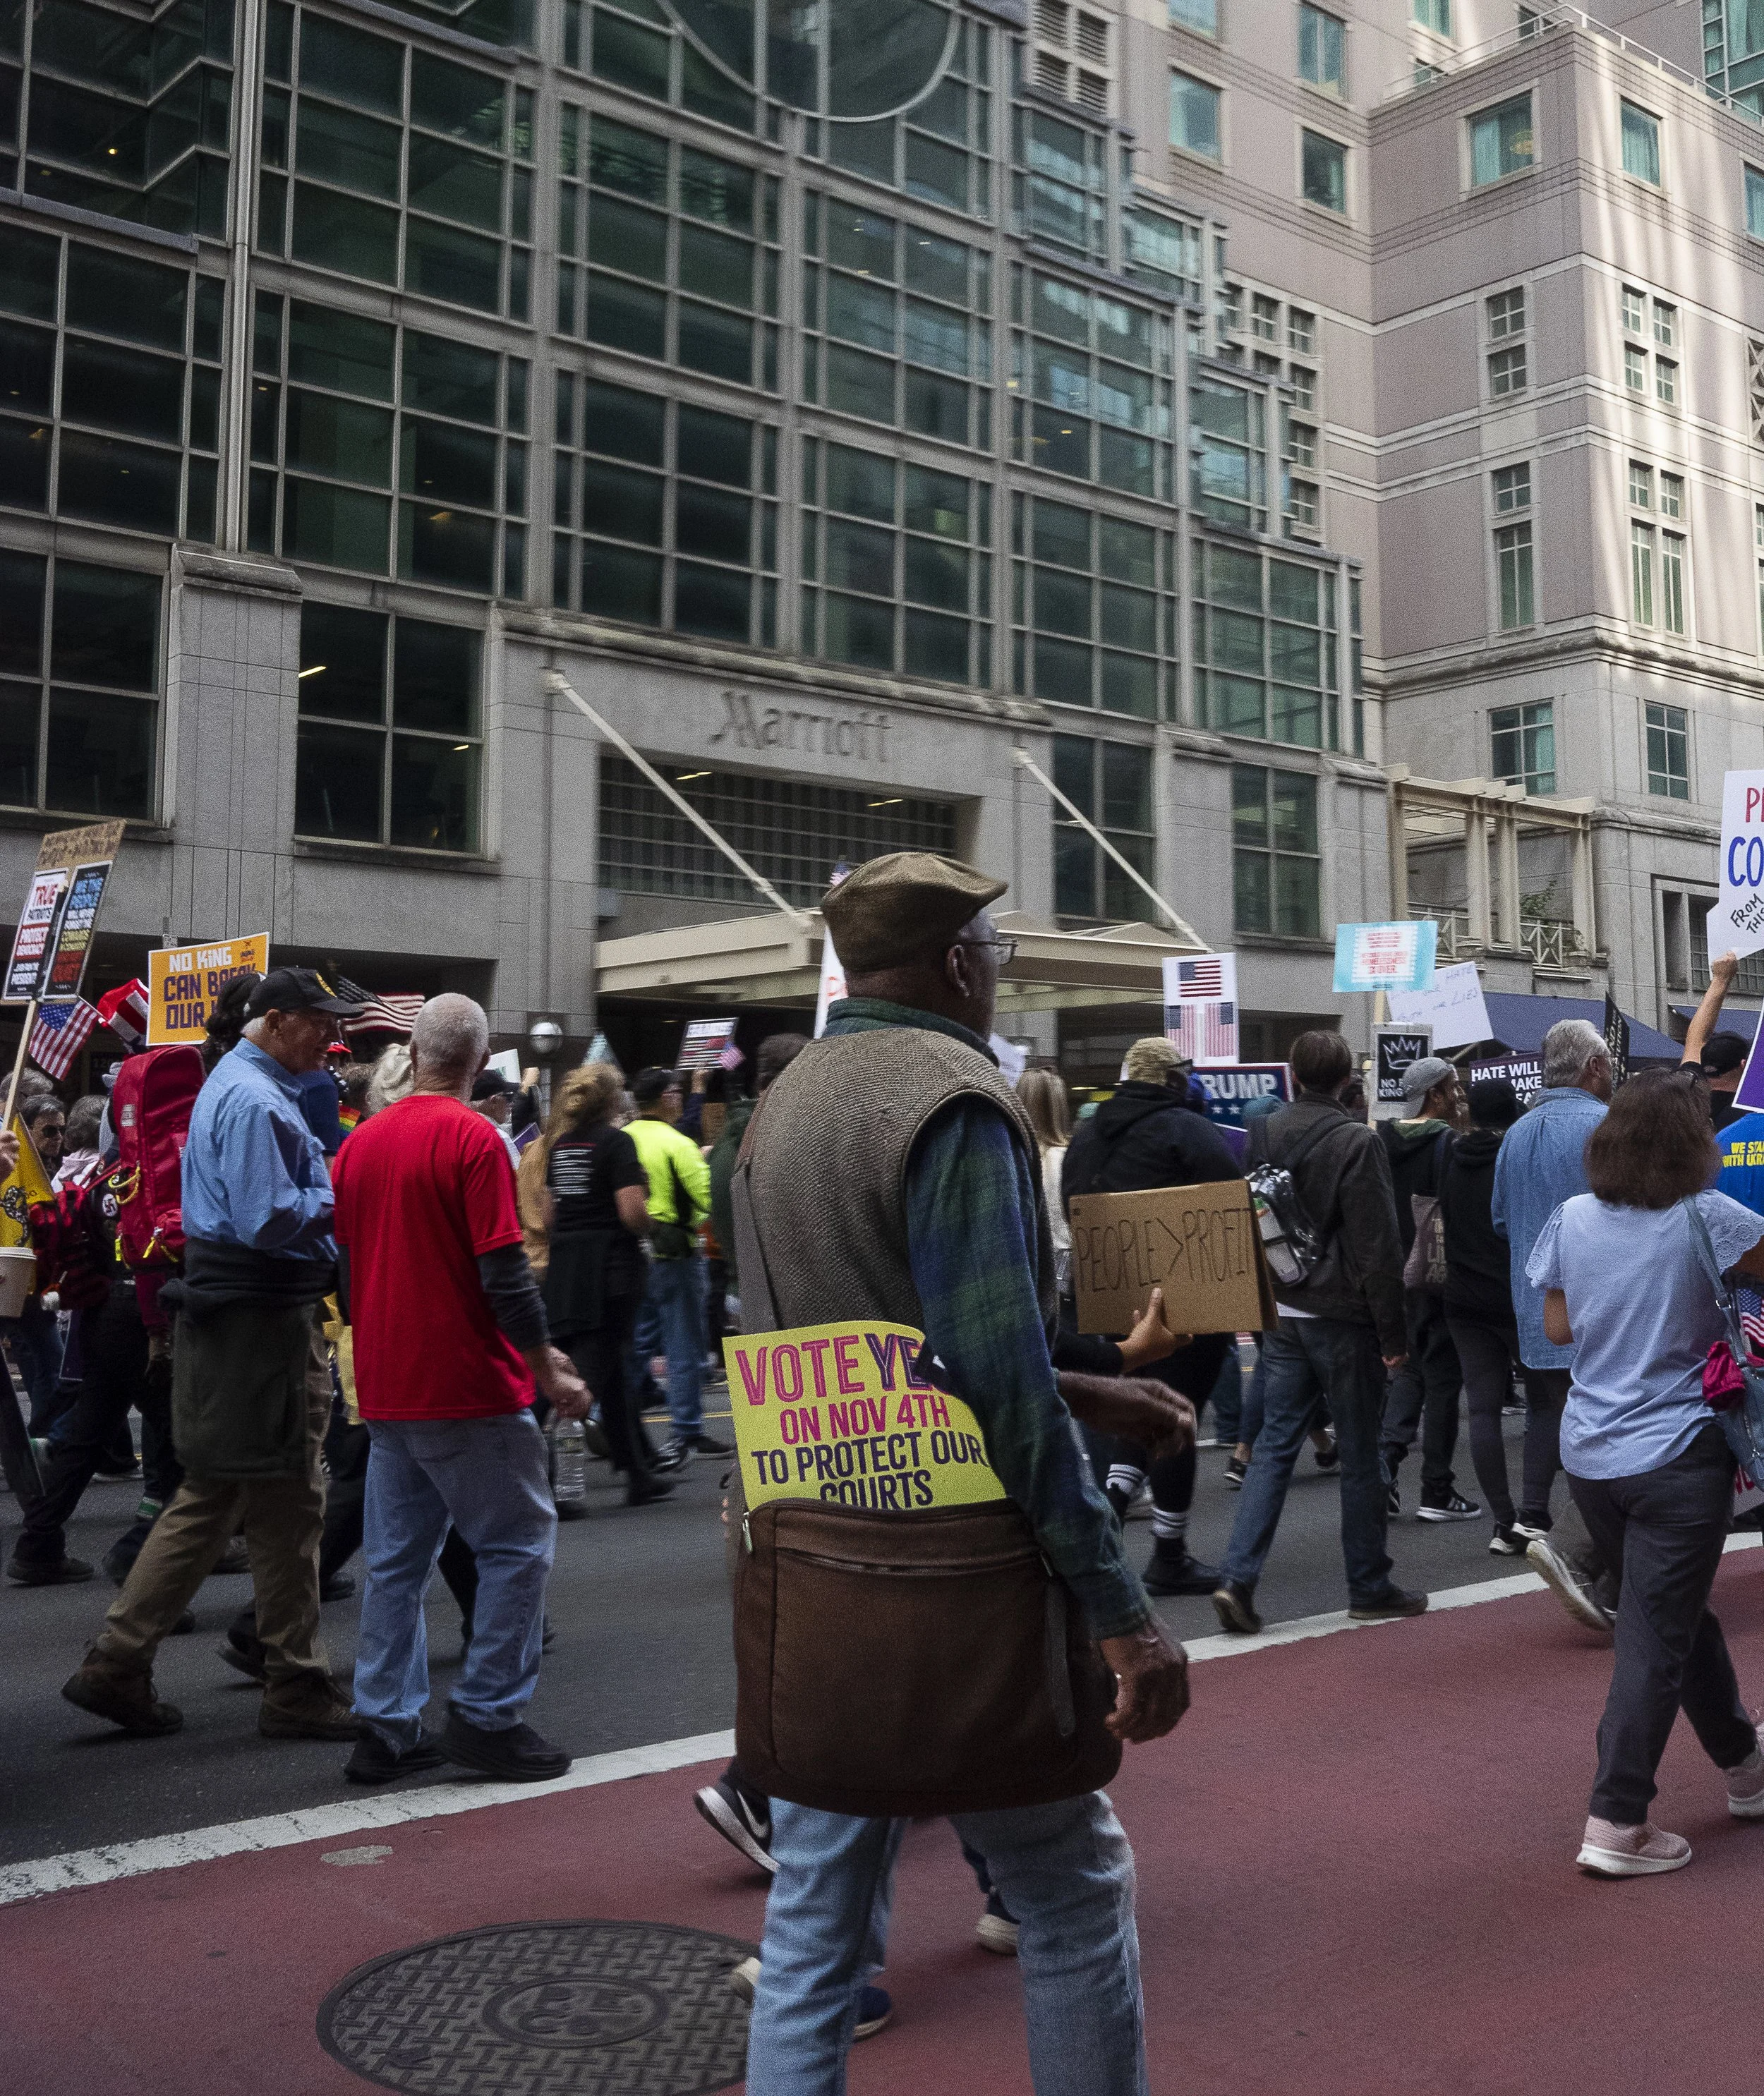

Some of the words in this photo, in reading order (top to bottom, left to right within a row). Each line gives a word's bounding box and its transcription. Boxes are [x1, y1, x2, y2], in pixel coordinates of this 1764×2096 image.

[710, 691, 892, 763] Marriott
[36, 883, 59, 907] TRUE
[1731, 893, 1764, 928] FROM
[169, 952, 193, 972] NO
[164, 973, 202, 1002] CAN
[166, 1001, 205, 1030] OUR
[1380, 1078, 1396, 1088] NO
[1470, 1065, 1506, 1082] HATE
[1509, 1061, 1542, 1077] WILL
[1200, 1074, 1279, 1099] RUMP
[1722, 1154, 1744, 1168] WITH
[1731, 1142, 1746, 1153] WE
[1075, 1219, 1161, 1293] PEOPLE
[735, 1334, 865, 1406] VOTE
[864, 1333, 950, 1395] YE
[779, 1405, 821, 1445] ON
[828, 1395, 888, 1440] NOV
[897, 1393, 952, 1429] 4TH
[751, 1449, 790, 1486] TO
[795, 1430, 922, 1483] PROTECT
[931, 1429, 991, 1469] OUR
